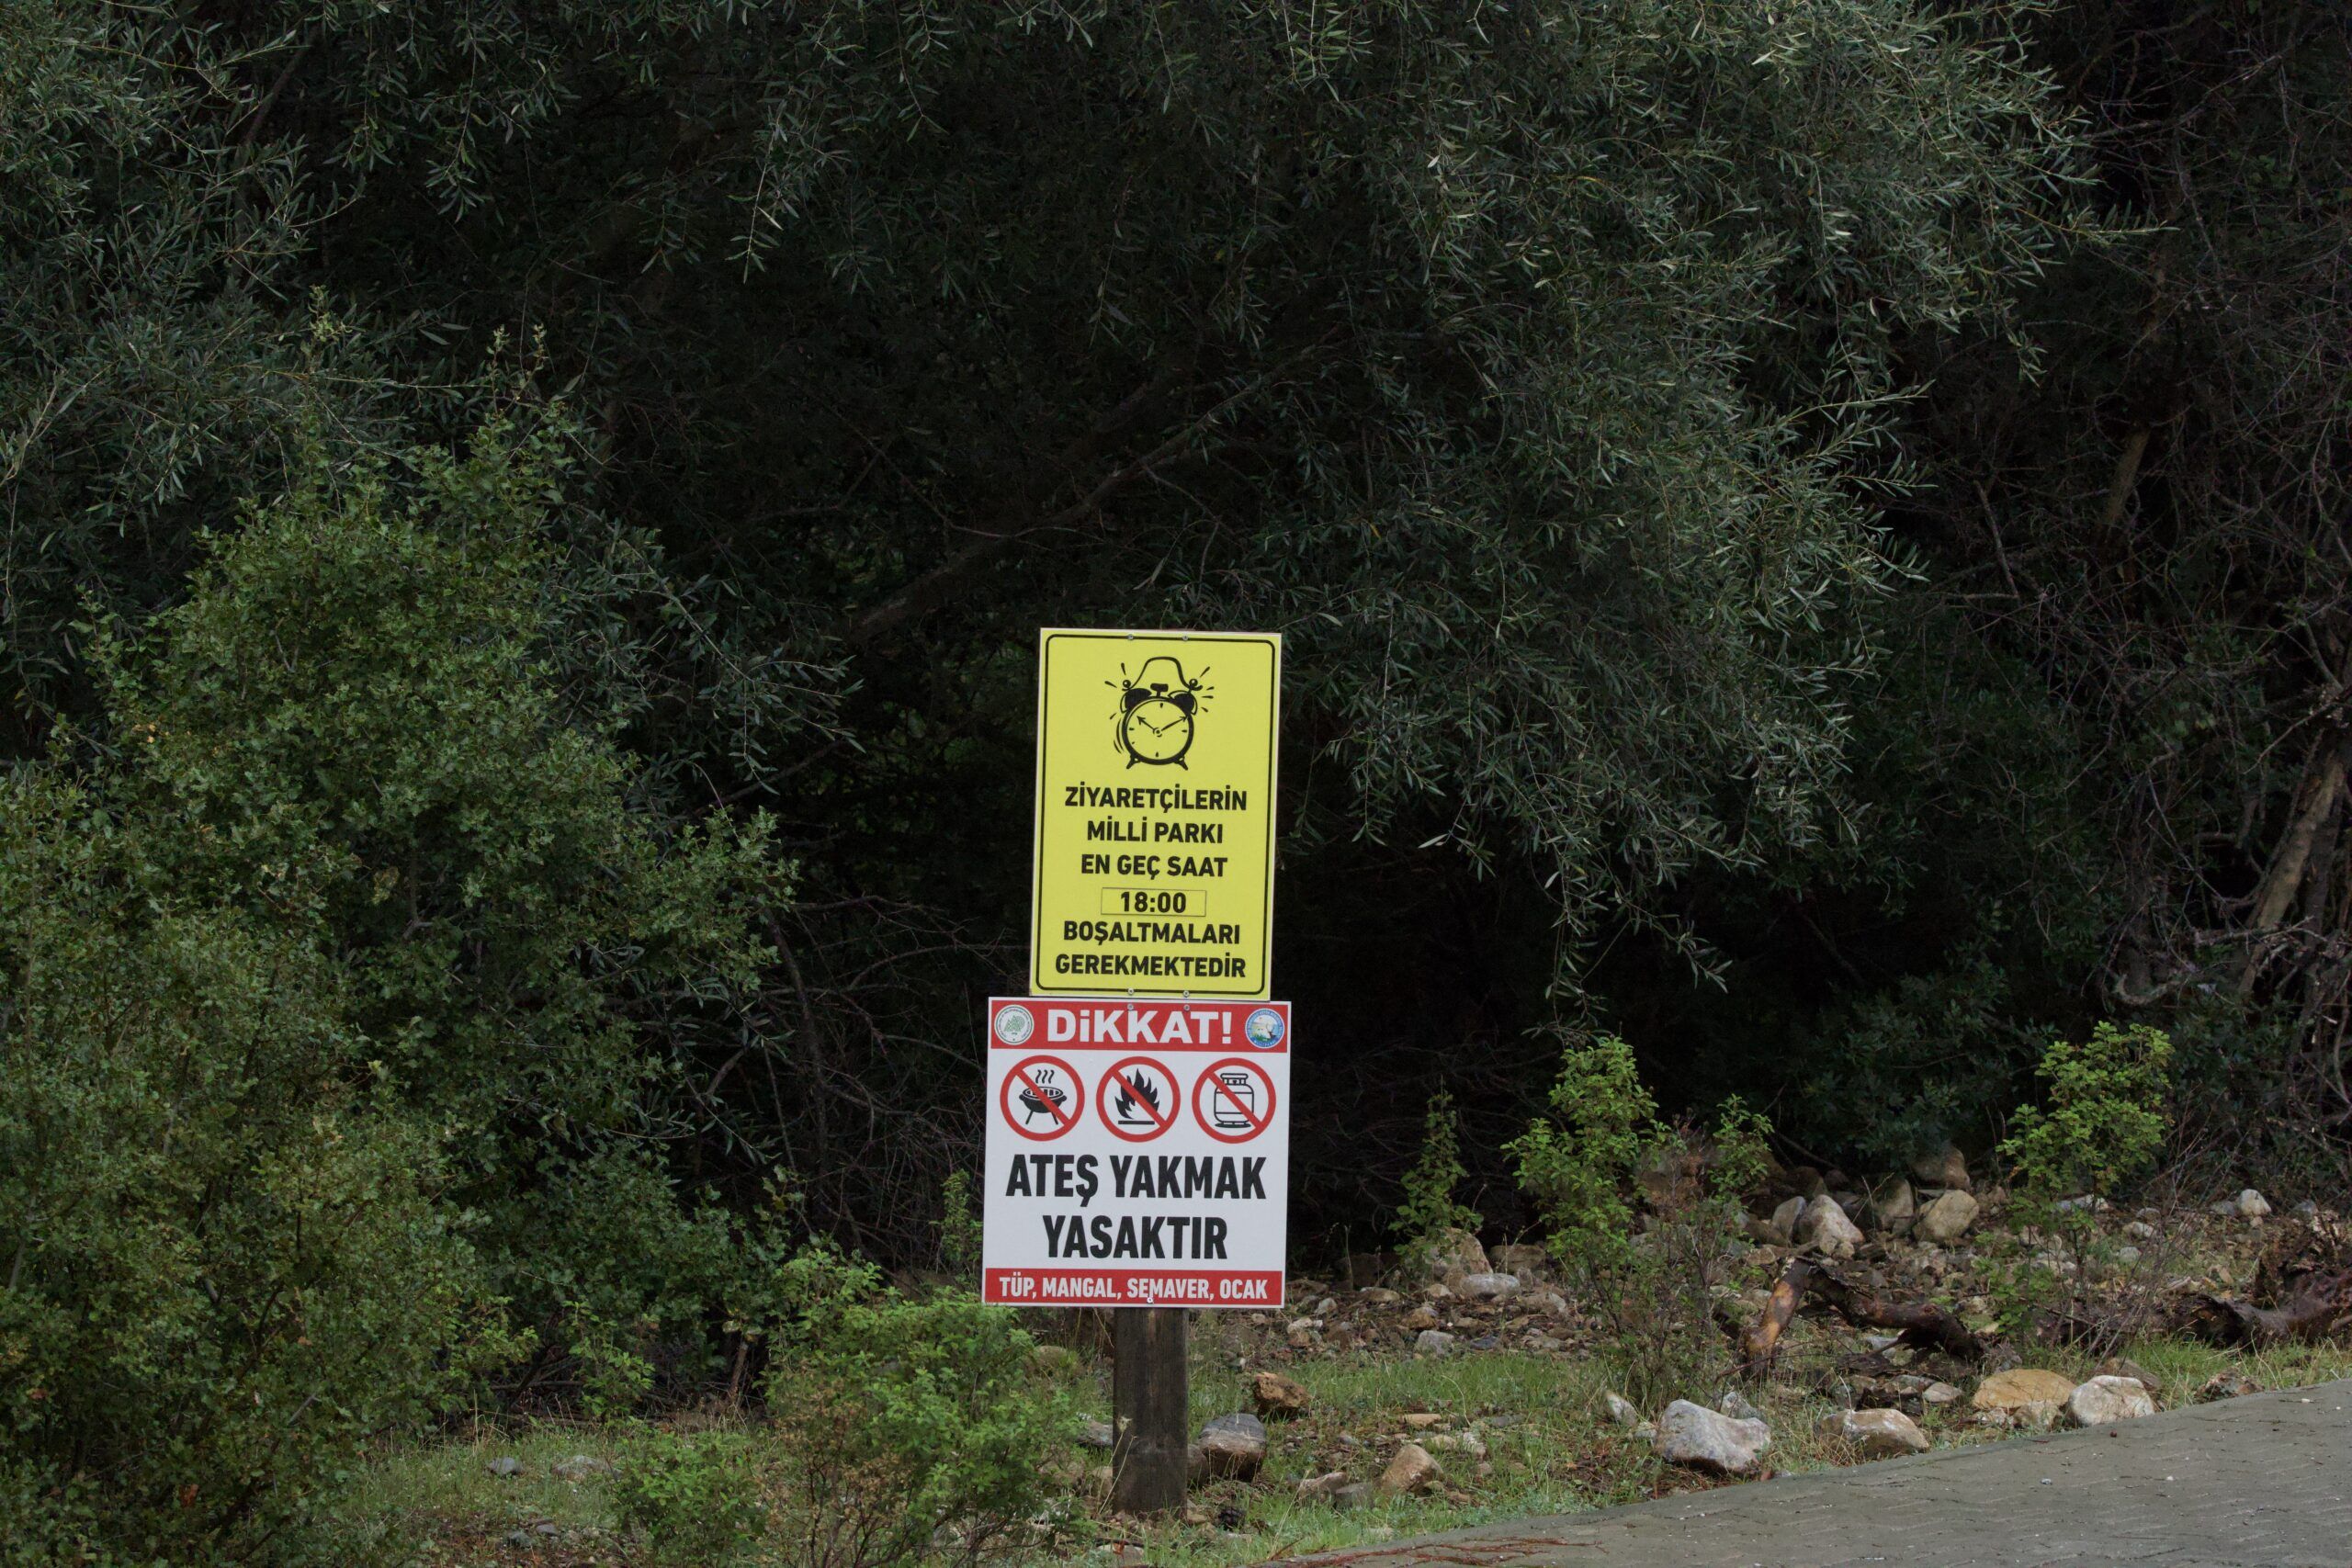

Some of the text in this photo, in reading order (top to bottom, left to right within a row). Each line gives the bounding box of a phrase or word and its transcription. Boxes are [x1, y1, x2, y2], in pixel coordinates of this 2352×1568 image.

[1065, 781, 1247, 814] ZİYARETÇİLERİN
[1087, 816, 1223, 843] MİLLİ PARKI
[1080, 853, 1228, 880] EN GEÇ SAAT
[1120, 891, 1187, 914] 18:00
[1063, 920, 1240, 946] BOŞALTMALARI
[1055, 952, 1246, 978] GEREKMEKTEDİR
[1005, 1154, 1267, 1208] ATEŞ YAKMAK
[1042, 1214, 1227, 1260] YASAKTIR
[999, 1271, 1268, 1301] TÜP, MANGAL, SEMAVER, OCAK
